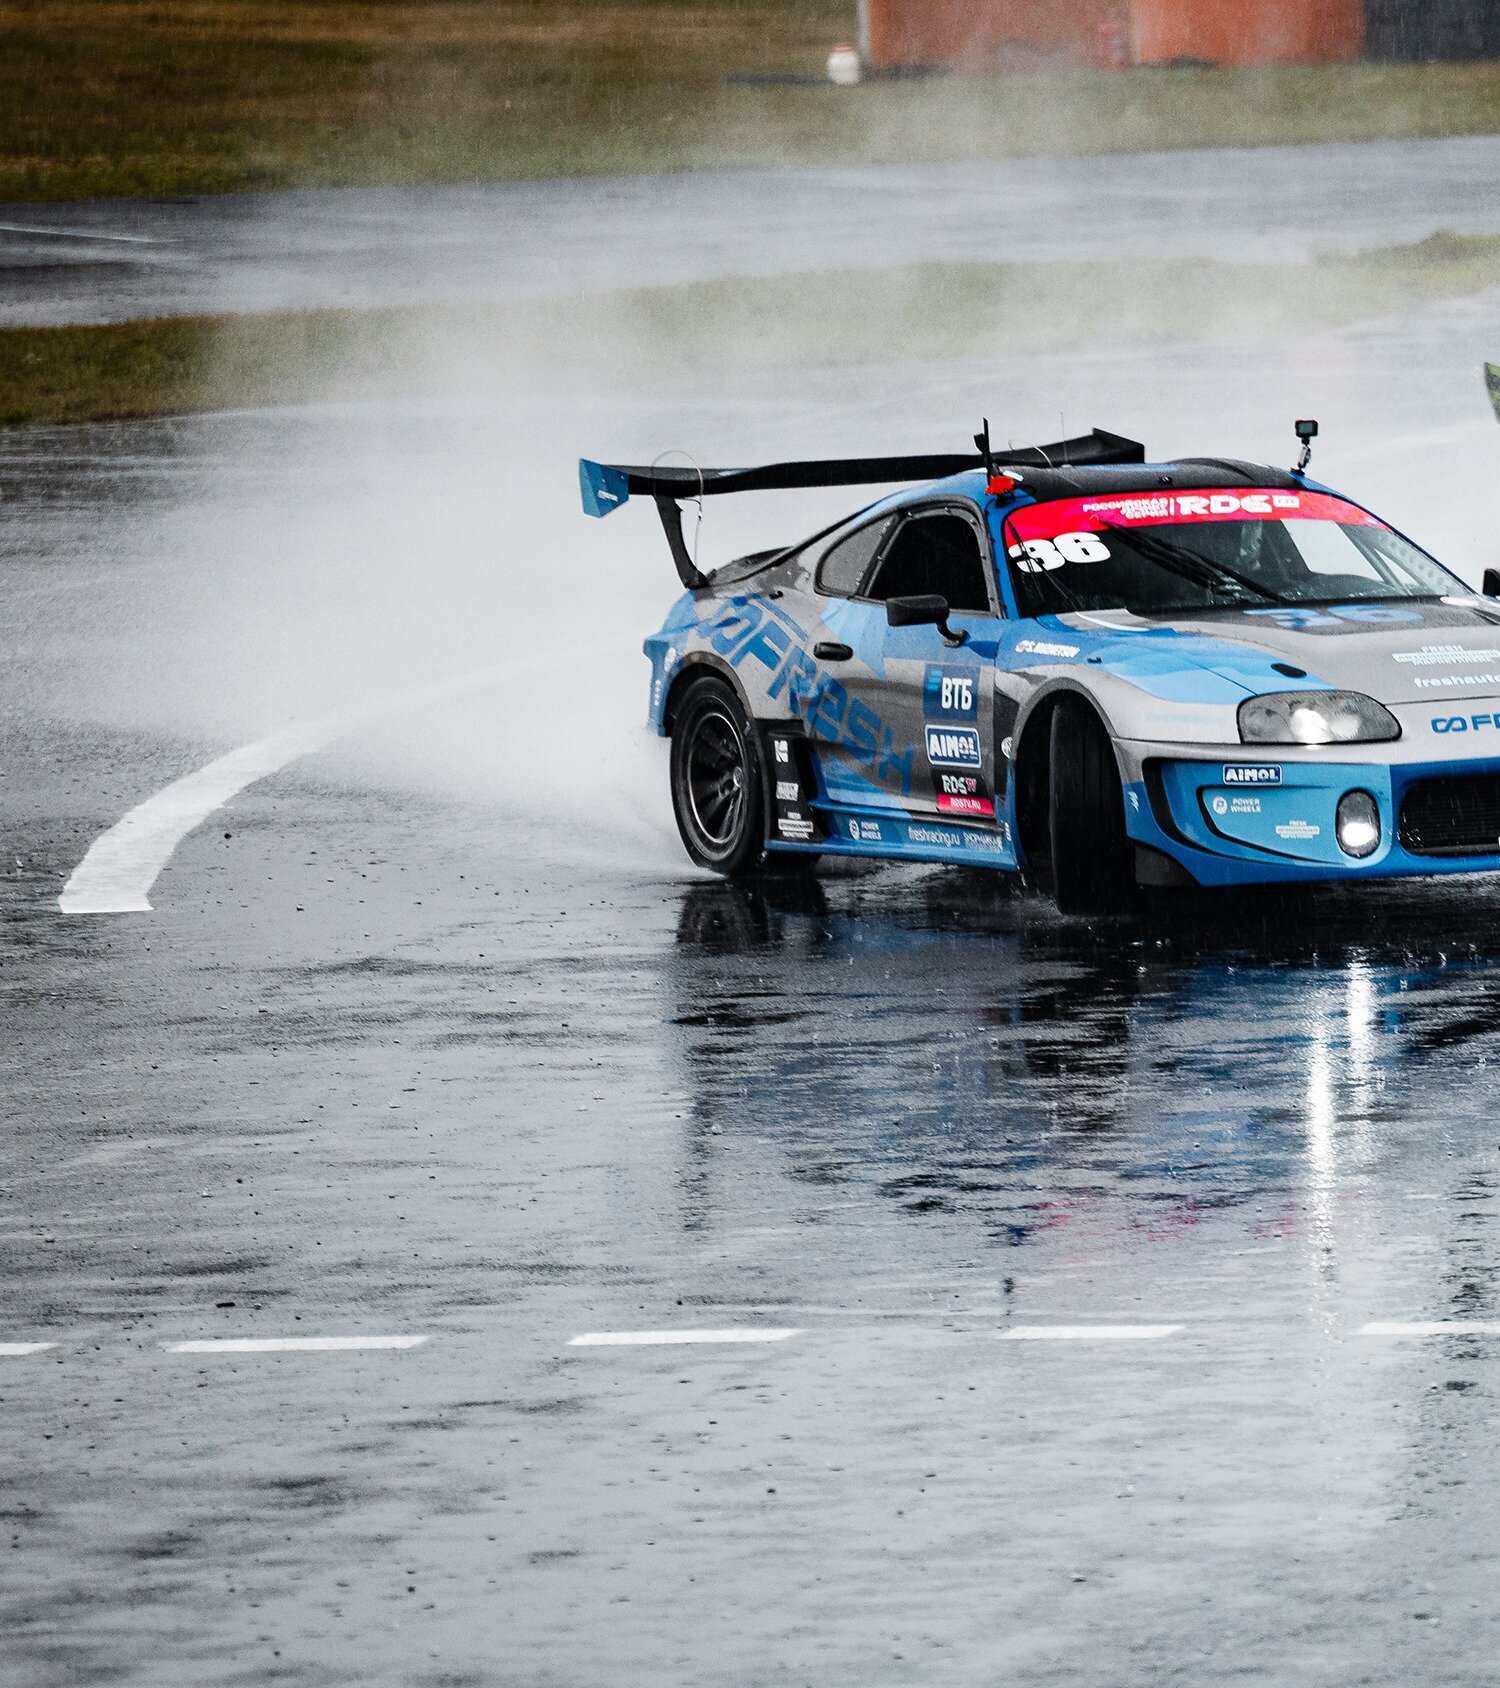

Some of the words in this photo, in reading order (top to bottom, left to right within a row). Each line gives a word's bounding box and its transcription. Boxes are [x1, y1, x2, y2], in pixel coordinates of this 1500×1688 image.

[1008, 532, 1111, 573] 36
[1226, 768, 1280, 783] AIMOL
[908, 826, 961, 846] freshracing.ru
